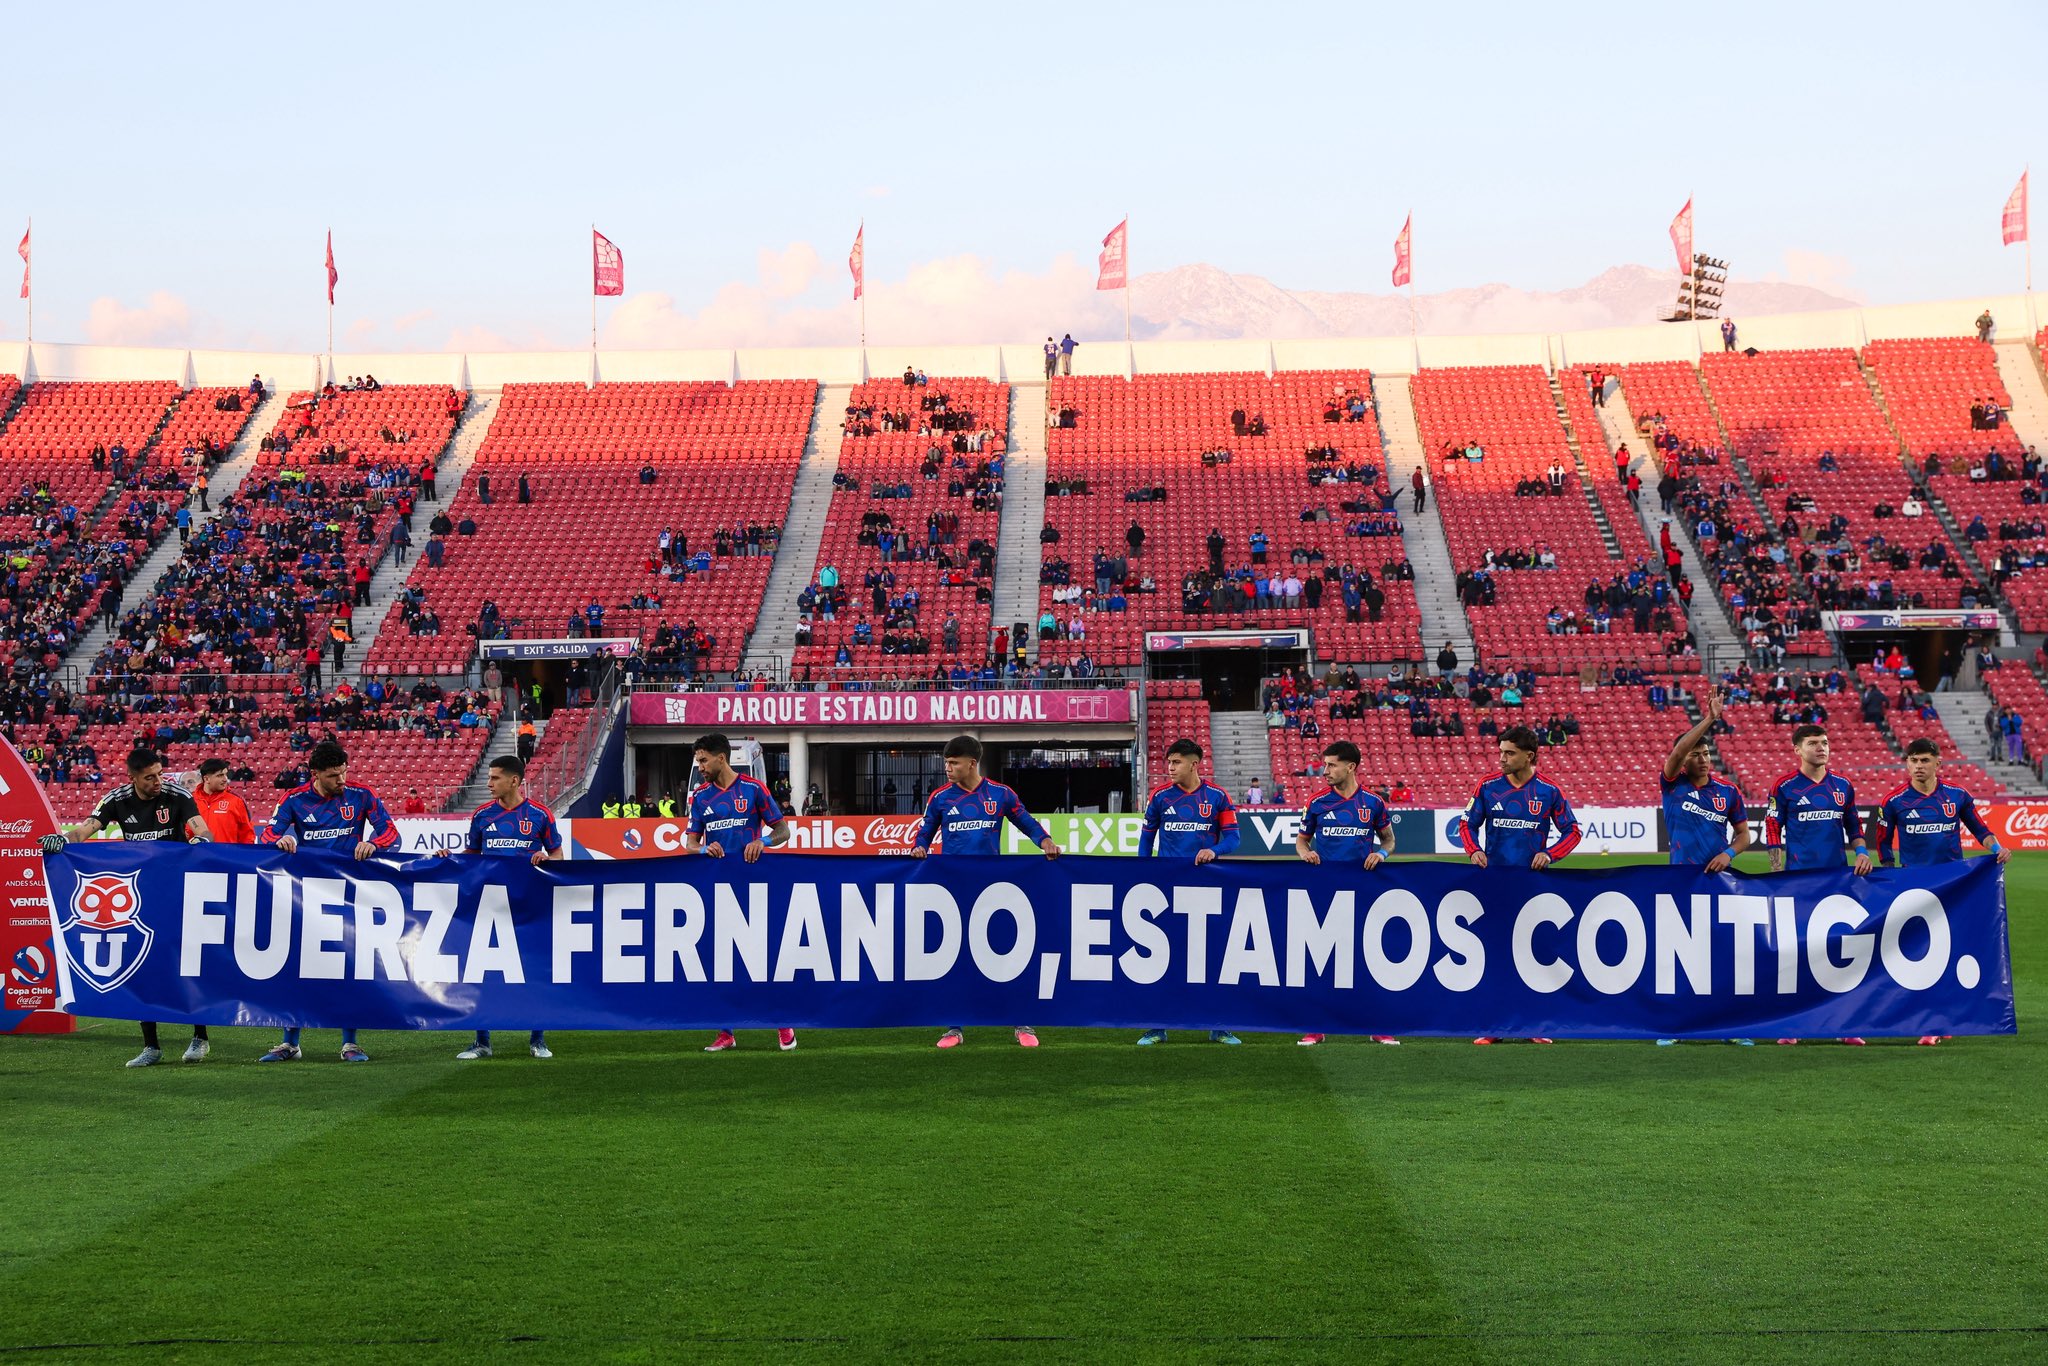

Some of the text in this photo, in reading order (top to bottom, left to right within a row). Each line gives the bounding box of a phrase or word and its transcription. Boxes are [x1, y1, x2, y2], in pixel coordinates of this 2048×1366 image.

[1842, 616, 1854, 626] 20
[1980, 614, 1992, 624] 20
[524, 646, 544, 655] EXIT
[552, 644, 588, 654] SALIDA
[613, 644, 625, 652] 22
[1153, 638, 1164, 648] 21
[717, 695, 1047, 724] PARQUE ESTADIO NACIONAL
[734, 798, 748, 812] U
[1712, 798, 1726, 811] U
[1832, 791, 1845, 806] U
[340, 806, 354, 820] U
[984, 800, 997, 815] U
[1198, 803, 1212, 818] U
[1528, 800, 1542, 815] U
[1942, 802, 1956, 818] U
[156, 808, 170, 824] U
[1358, 808, 1371, 822] U
[519, 820, 532, 835] U
[2022, 838, 2046, 847] zero
[9, 897, 48, 908] VENTUS
[179, 871, 526, 984] FUERZA
[1512, 888, 1981, 995] CONTIGO.
[80, 932, 128, 977] U
[8, 988, 30, 996] Copa
